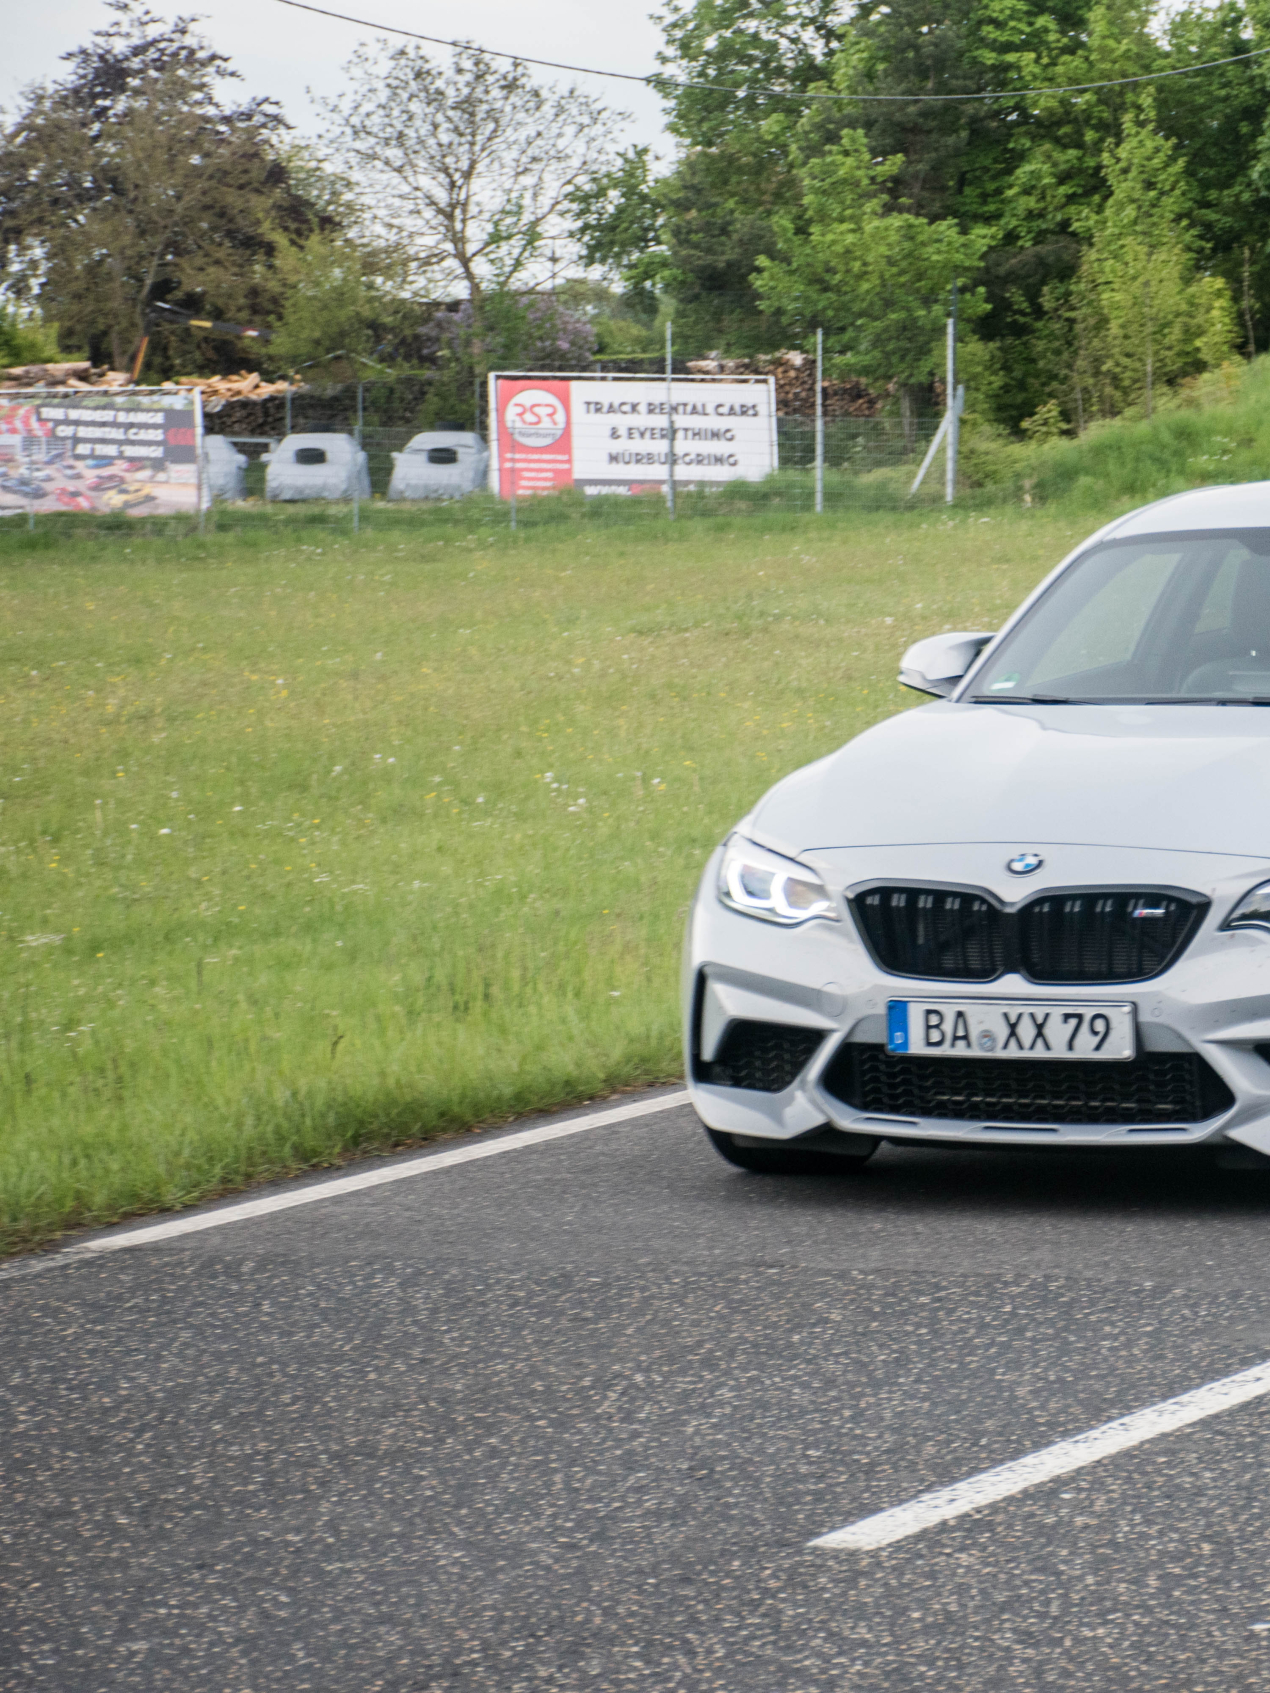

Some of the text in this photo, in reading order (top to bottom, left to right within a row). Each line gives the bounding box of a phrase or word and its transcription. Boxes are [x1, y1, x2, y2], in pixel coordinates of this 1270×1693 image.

[39, 407, 67, 420] THE
[116, 410, 165, 424] RANGE
[513, 403, 558, 426] RSR
[584, 401, 759, 417] TRACK RENTAL CARS
[55, 425, 76, 438] OF
[127, 428, 165, 441] CARS
[610, 426, 622, 440] &
[924, 1008, 972, 1049] BA
